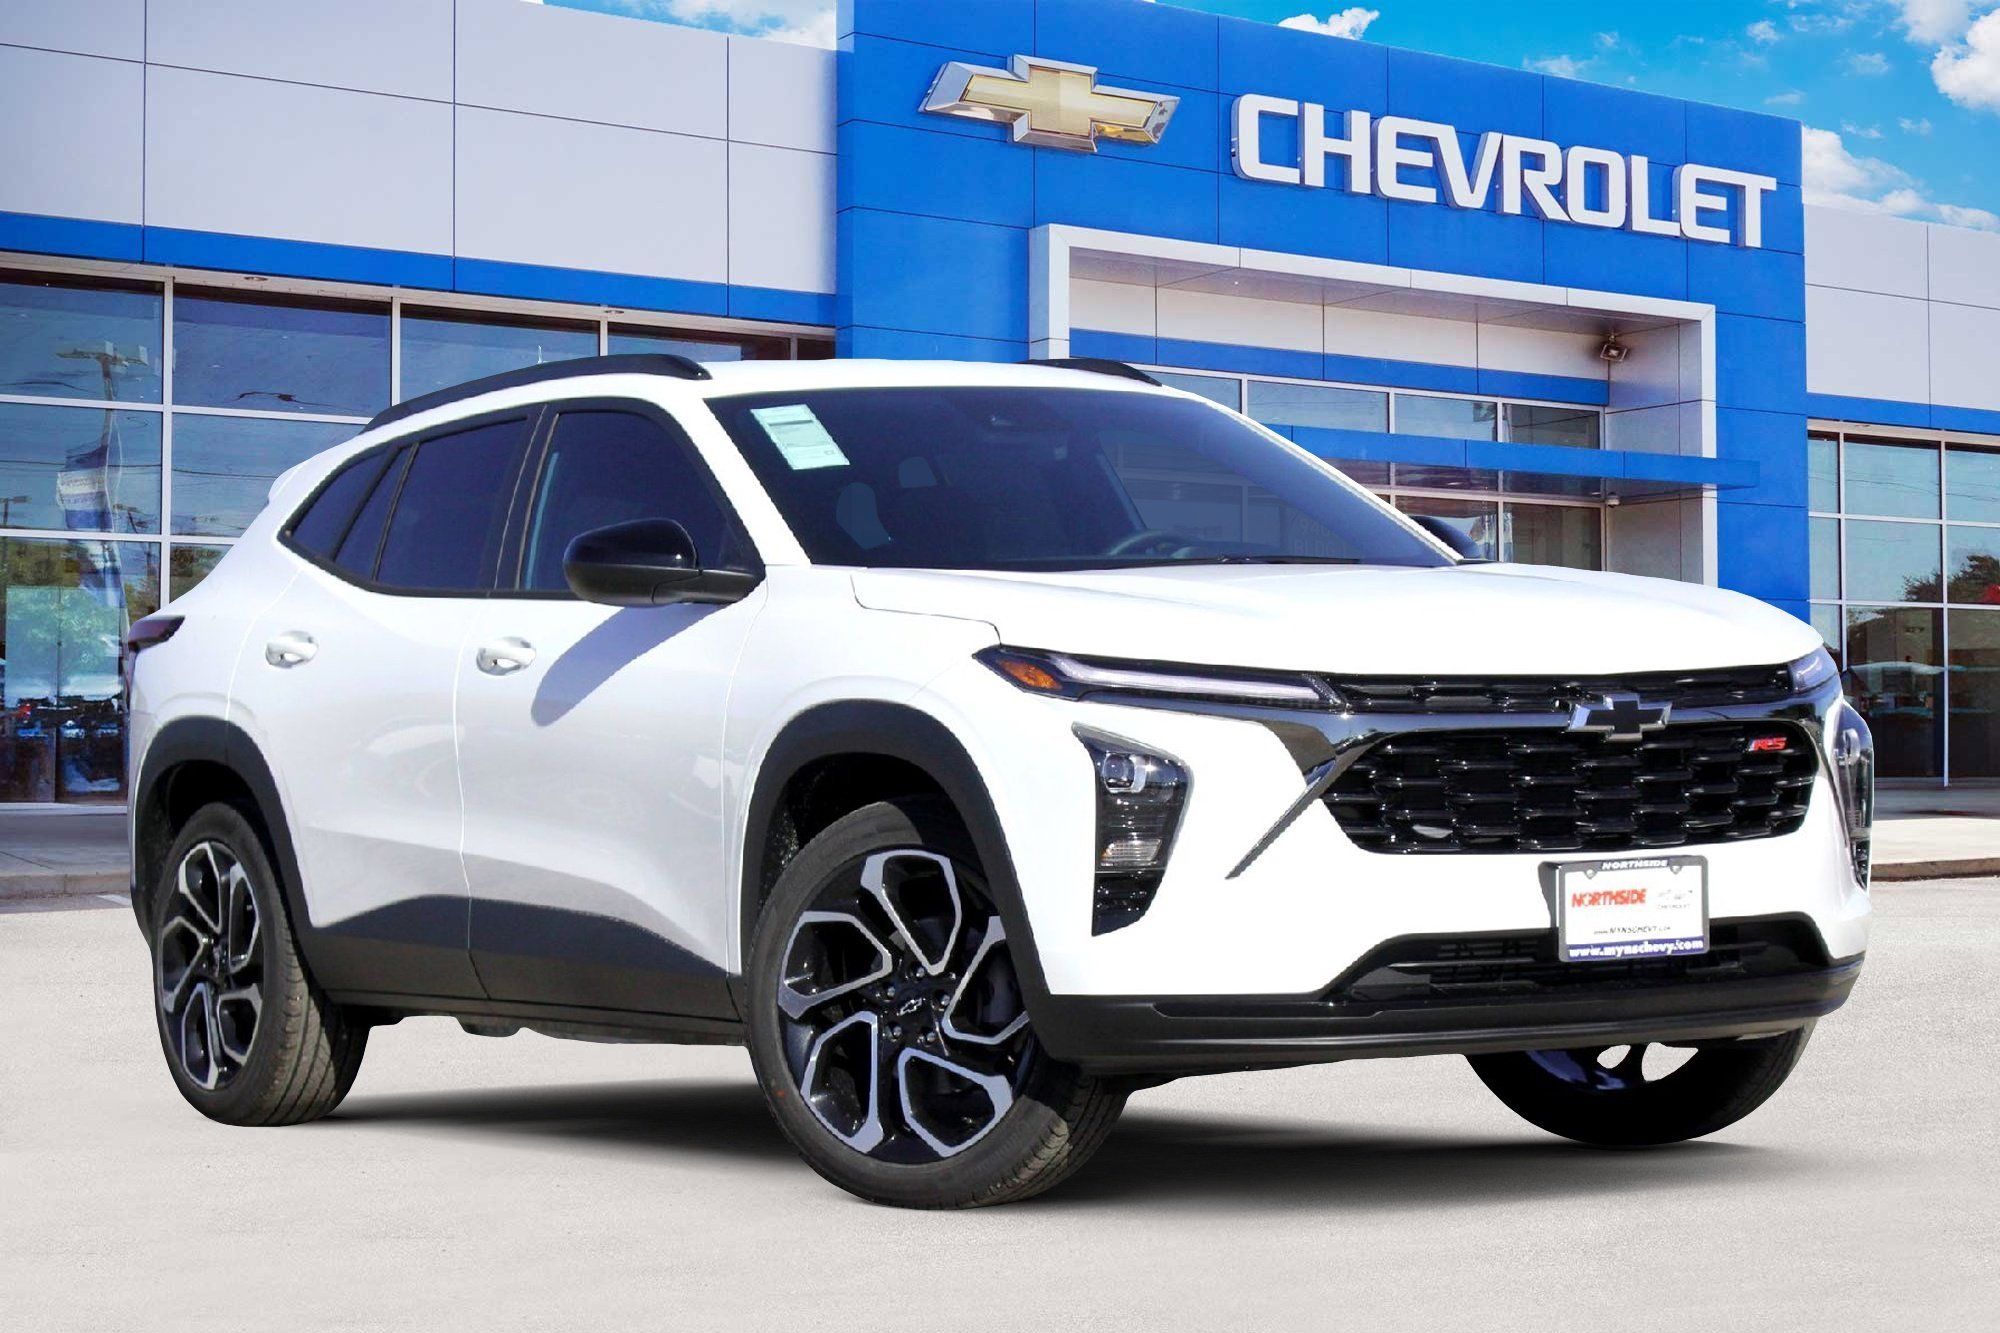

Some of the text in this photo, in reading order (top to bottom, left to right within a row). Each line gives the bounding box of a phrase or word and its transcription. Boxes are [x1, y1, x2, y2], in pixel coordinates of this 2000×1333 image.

[1231, 93, 1777, 248] CHEVROLET
[1749, 737, 1787, 751] RS
[1601, 859, 1669, 870] NORTHSIDE
[1572, 888, 1647, 908] NORTHSIDE
[1568, 940, 1704, 957] www.mynschevy.com
